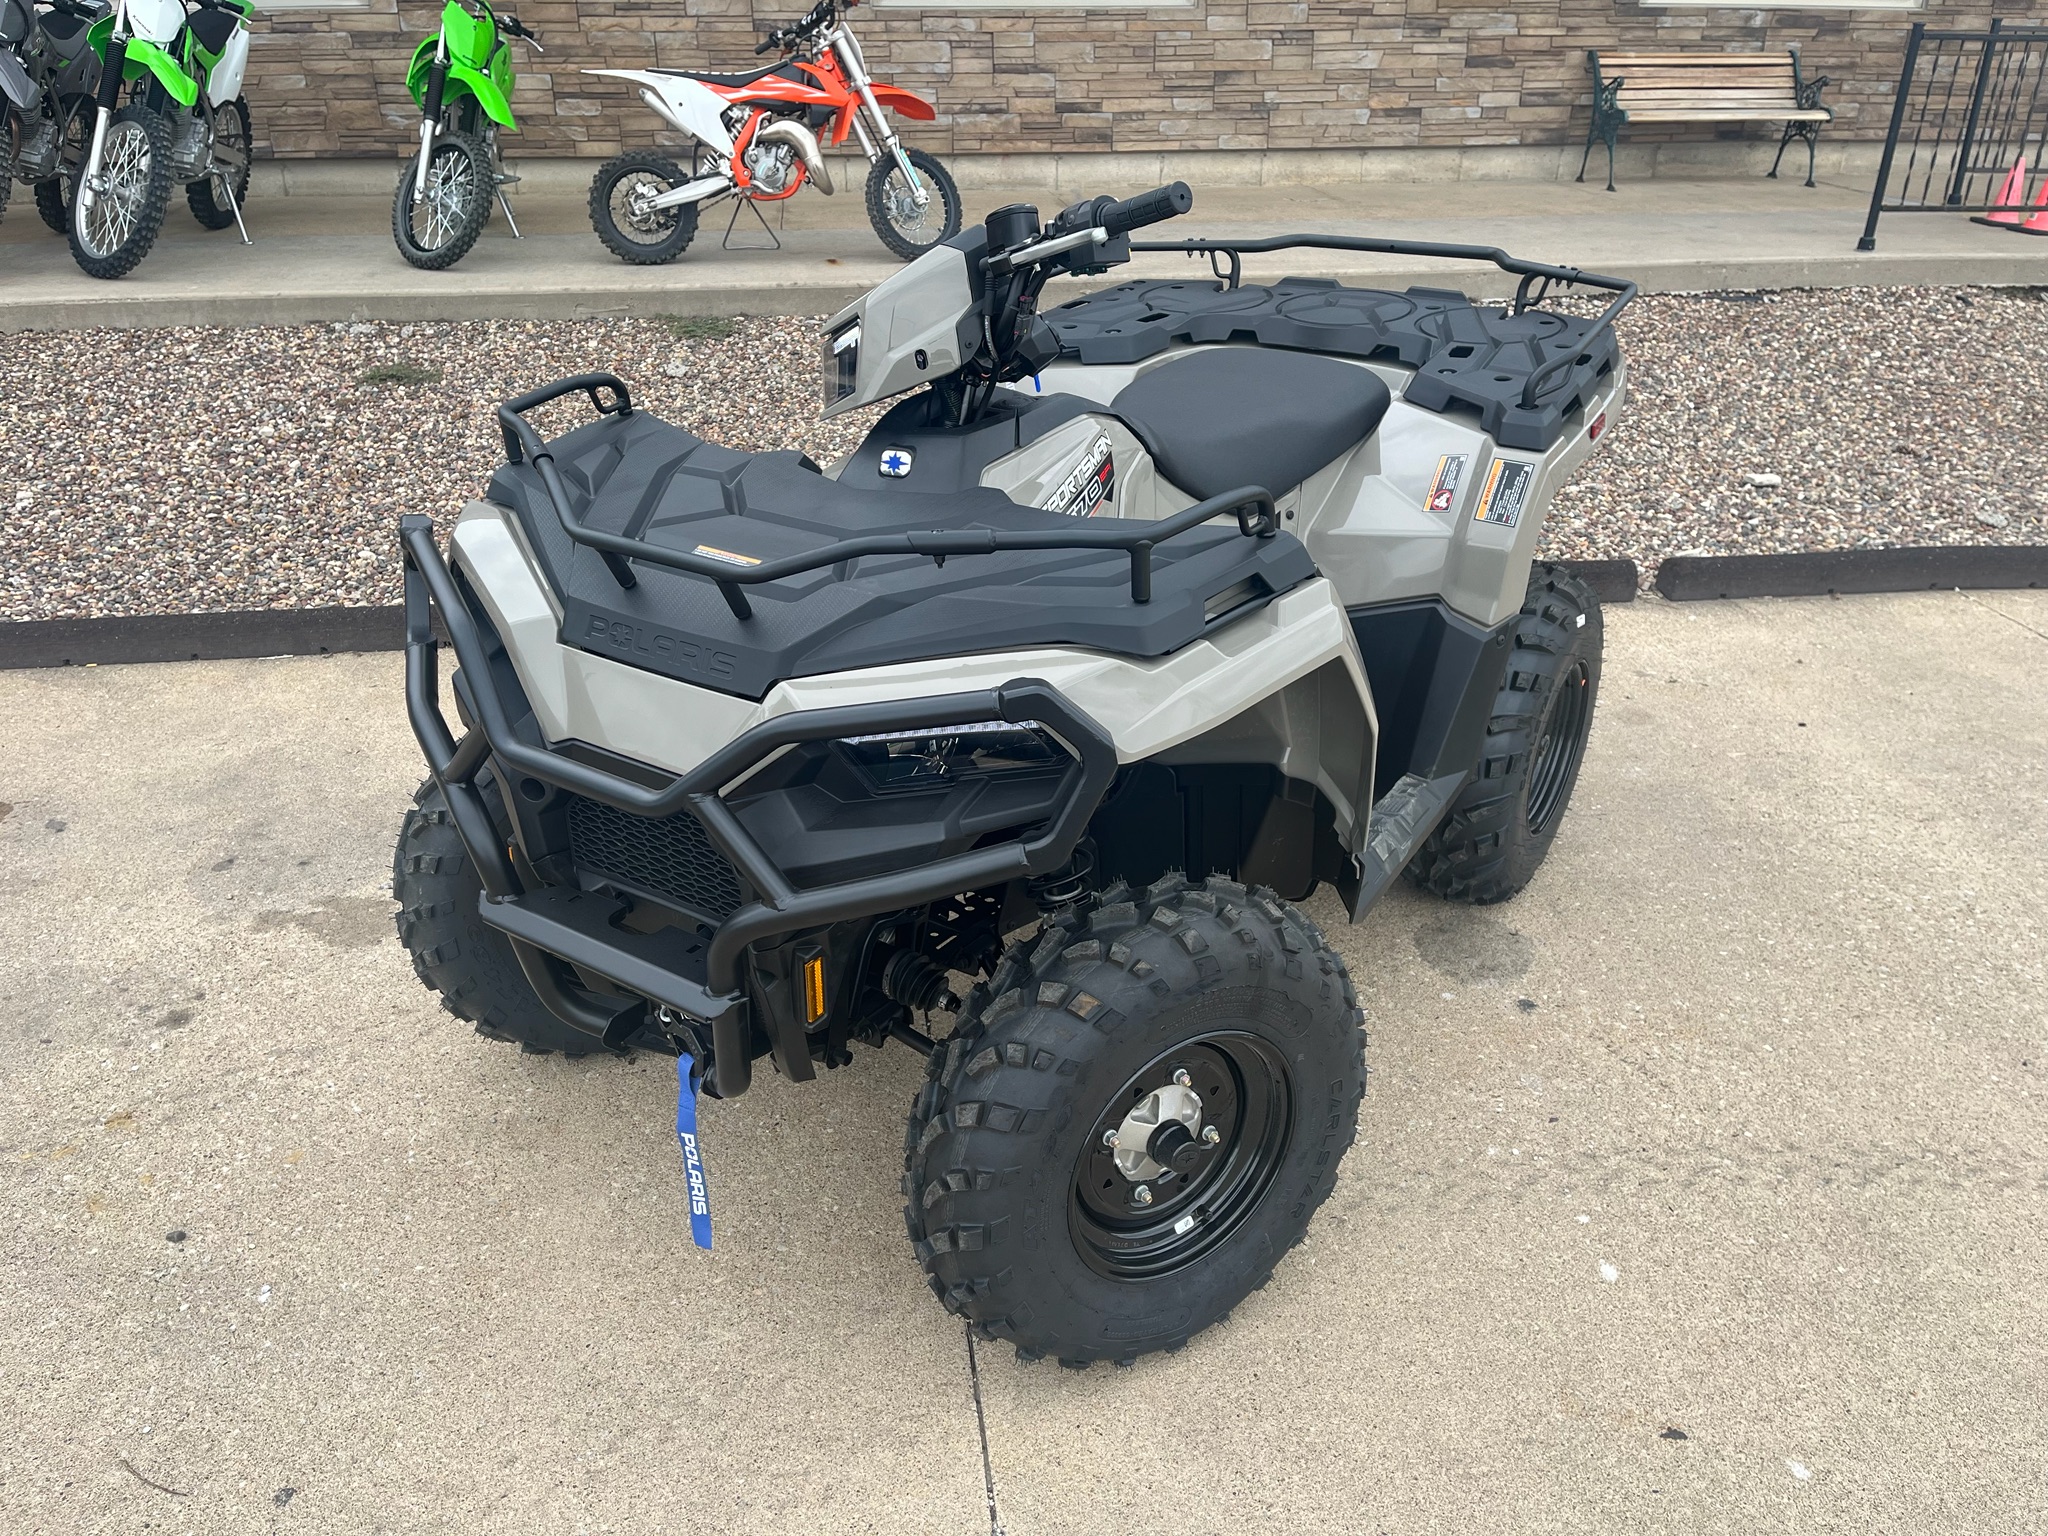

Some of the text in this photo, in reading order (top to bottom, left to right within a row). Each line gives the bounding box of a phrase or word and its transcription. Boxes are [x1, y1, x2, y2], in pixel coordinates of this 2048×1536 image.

[1483, 473, 1497, 500] WARNING
[584, 614, 738, 681] POLARIS
[680, 1132, 707, 1215] POLARIS
